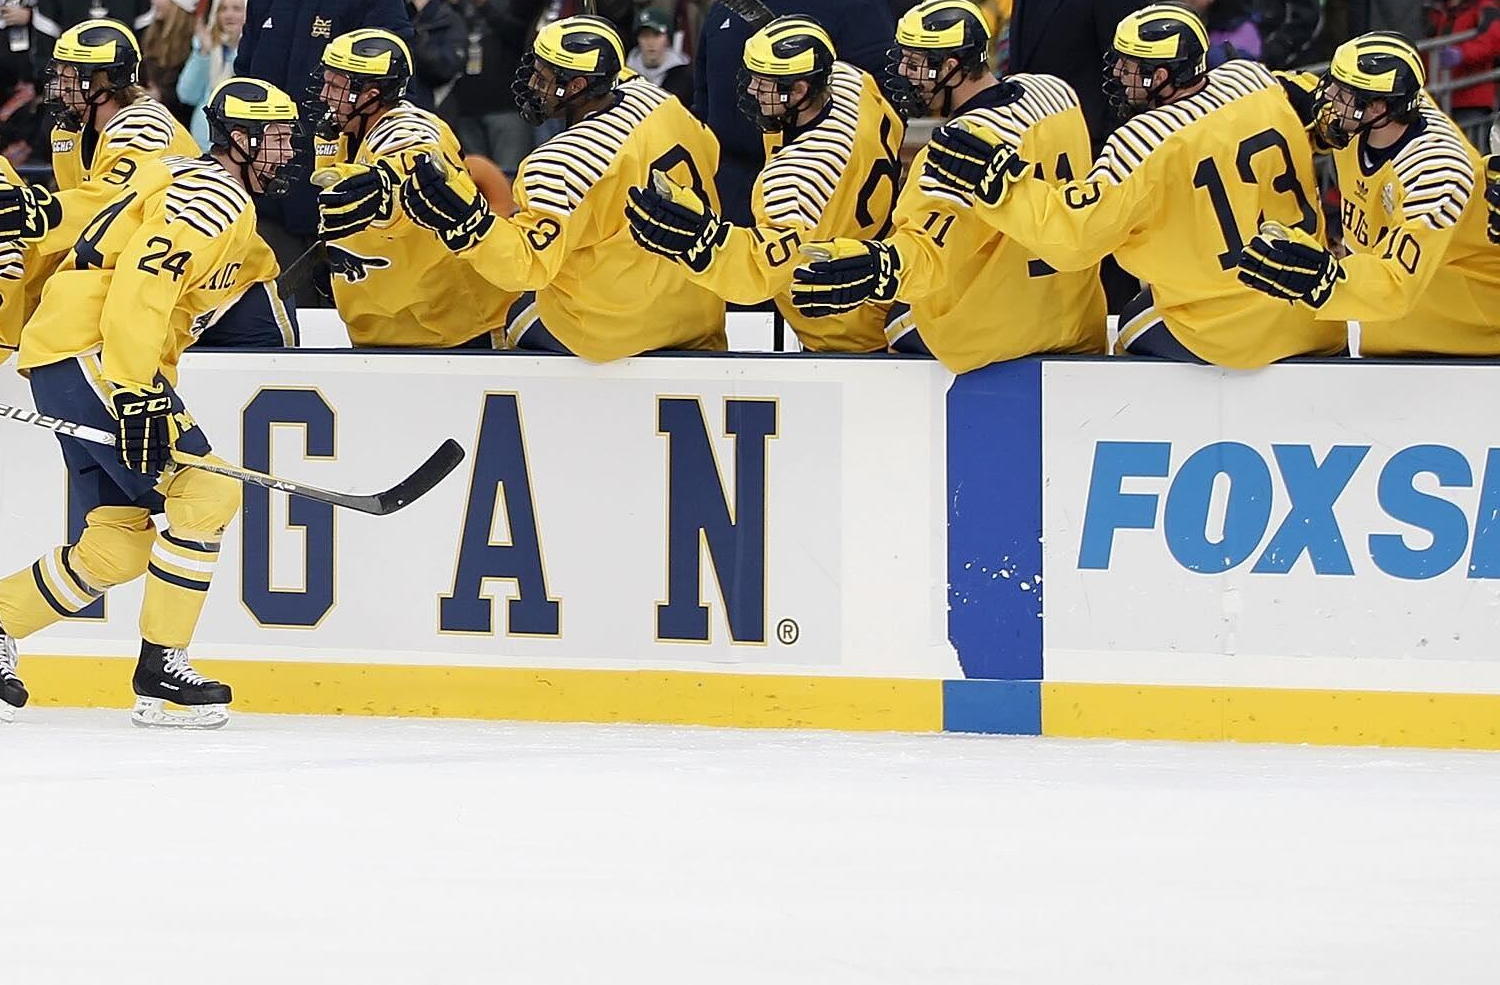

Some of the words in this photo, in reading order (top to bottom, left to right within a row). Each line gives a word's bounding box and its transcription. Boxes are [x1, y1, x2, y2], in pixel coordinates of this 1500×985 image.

[1193, 129, 1317, 271] 13
[923, 212, 957, 248] 11
[1382, 225, 1421, 275] 10
[137, 236, 192, 282] 24
[1078, 440, 1372, 577] FOX
